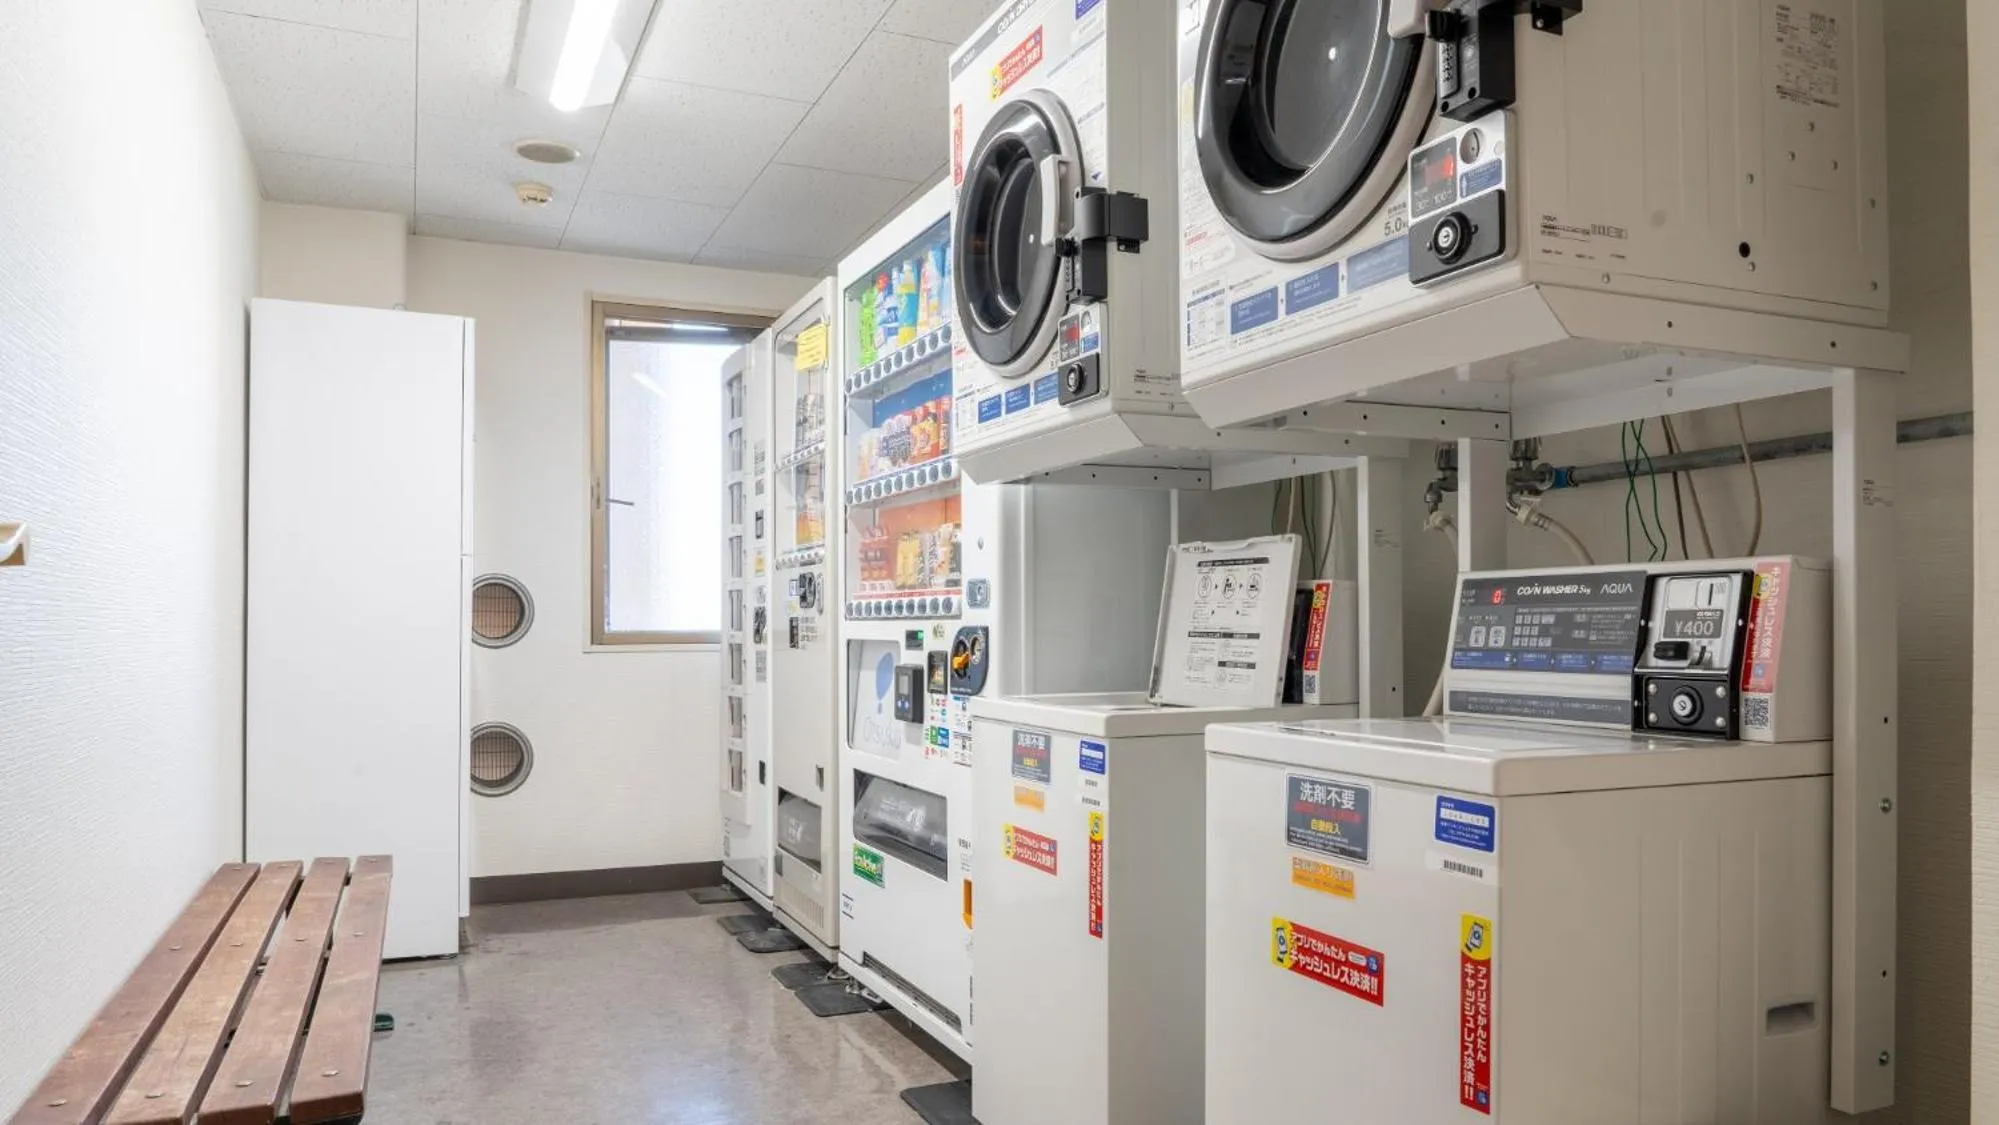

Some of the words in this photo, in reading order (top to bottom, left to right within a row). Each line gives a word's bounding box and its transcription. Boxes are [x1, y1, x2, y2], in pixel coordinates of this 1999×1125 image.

[1542, 584, 1578, 595] WASHER
[1600, 583, 1634, 595] AQUA
[1675, 620, 1714, 636] ¥400
[1299, 781, 1356, 810] 洗剤不要
[1290, 931, 1347, 962] アプリでかんたん
